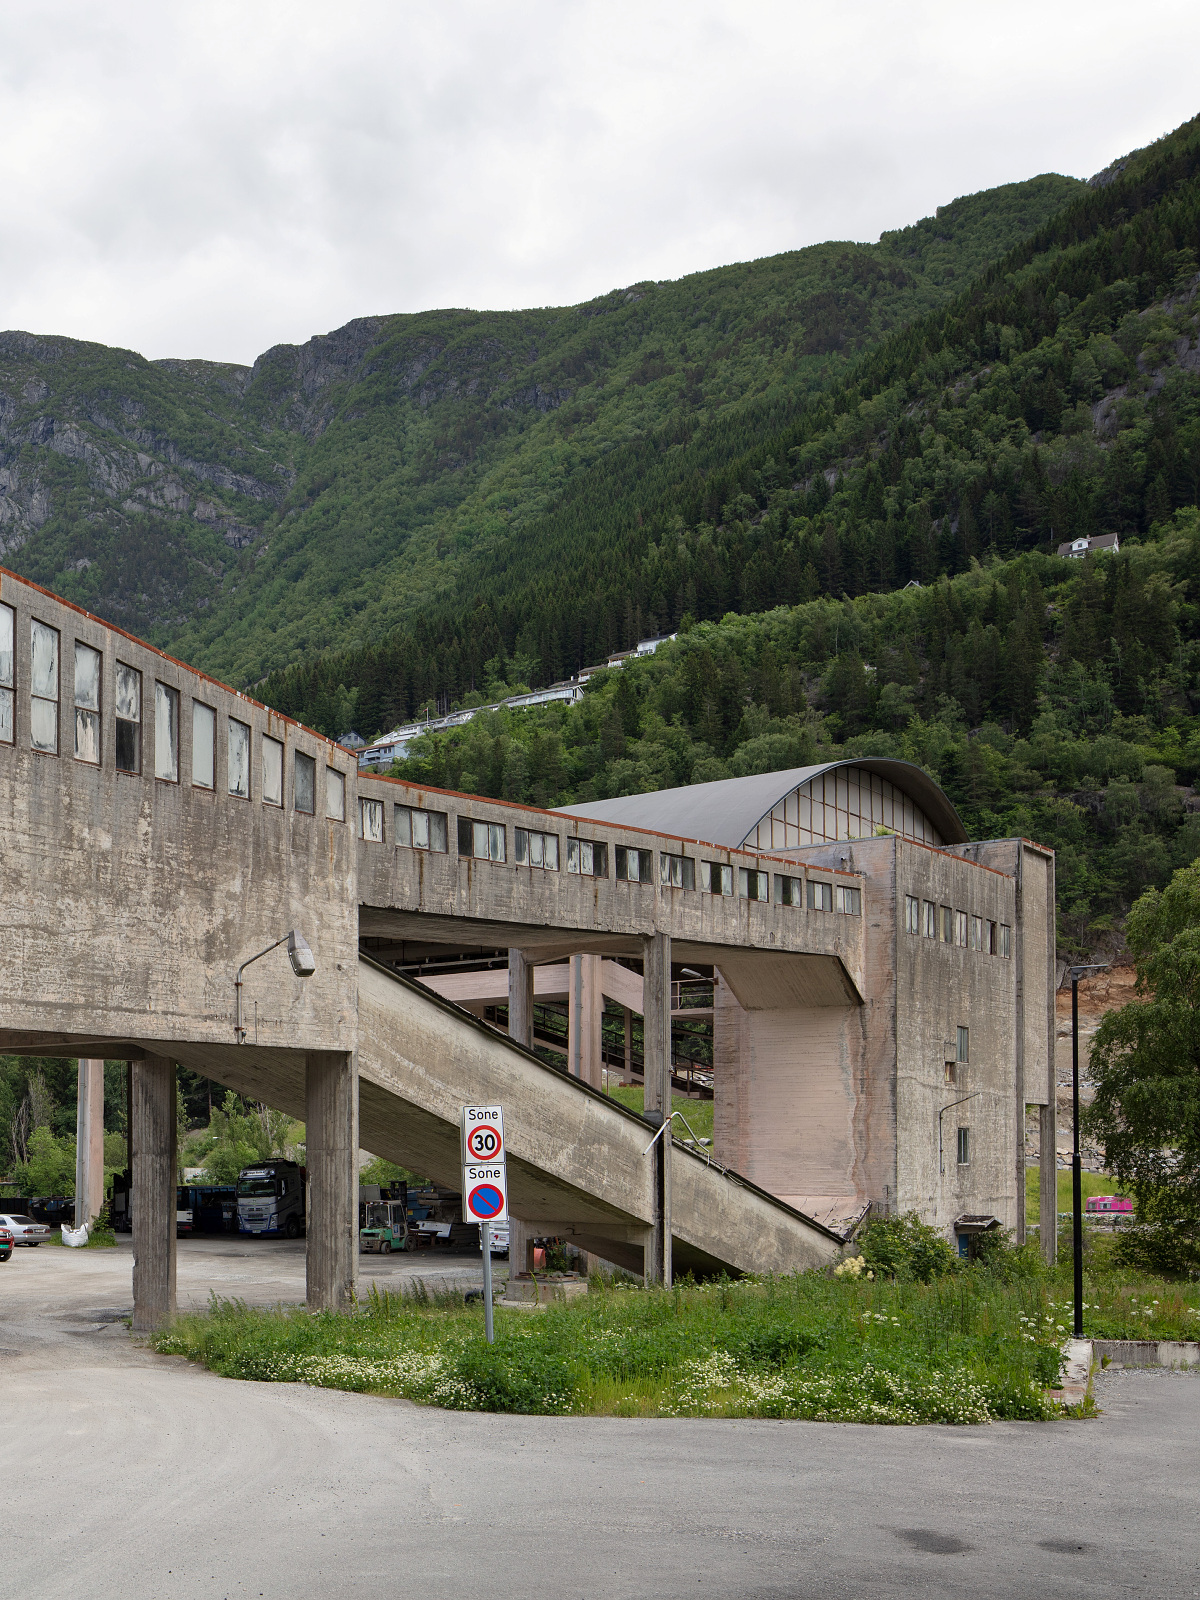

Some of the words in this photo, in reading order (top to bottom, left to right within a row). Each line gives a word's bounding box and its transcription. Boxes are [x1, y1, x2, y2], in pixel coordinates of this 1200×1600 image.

[468, 1109, 499, 1121] Sone
[474, 1134, 496, 1152] 30
[469, 1167, 501, 1179] Sone
